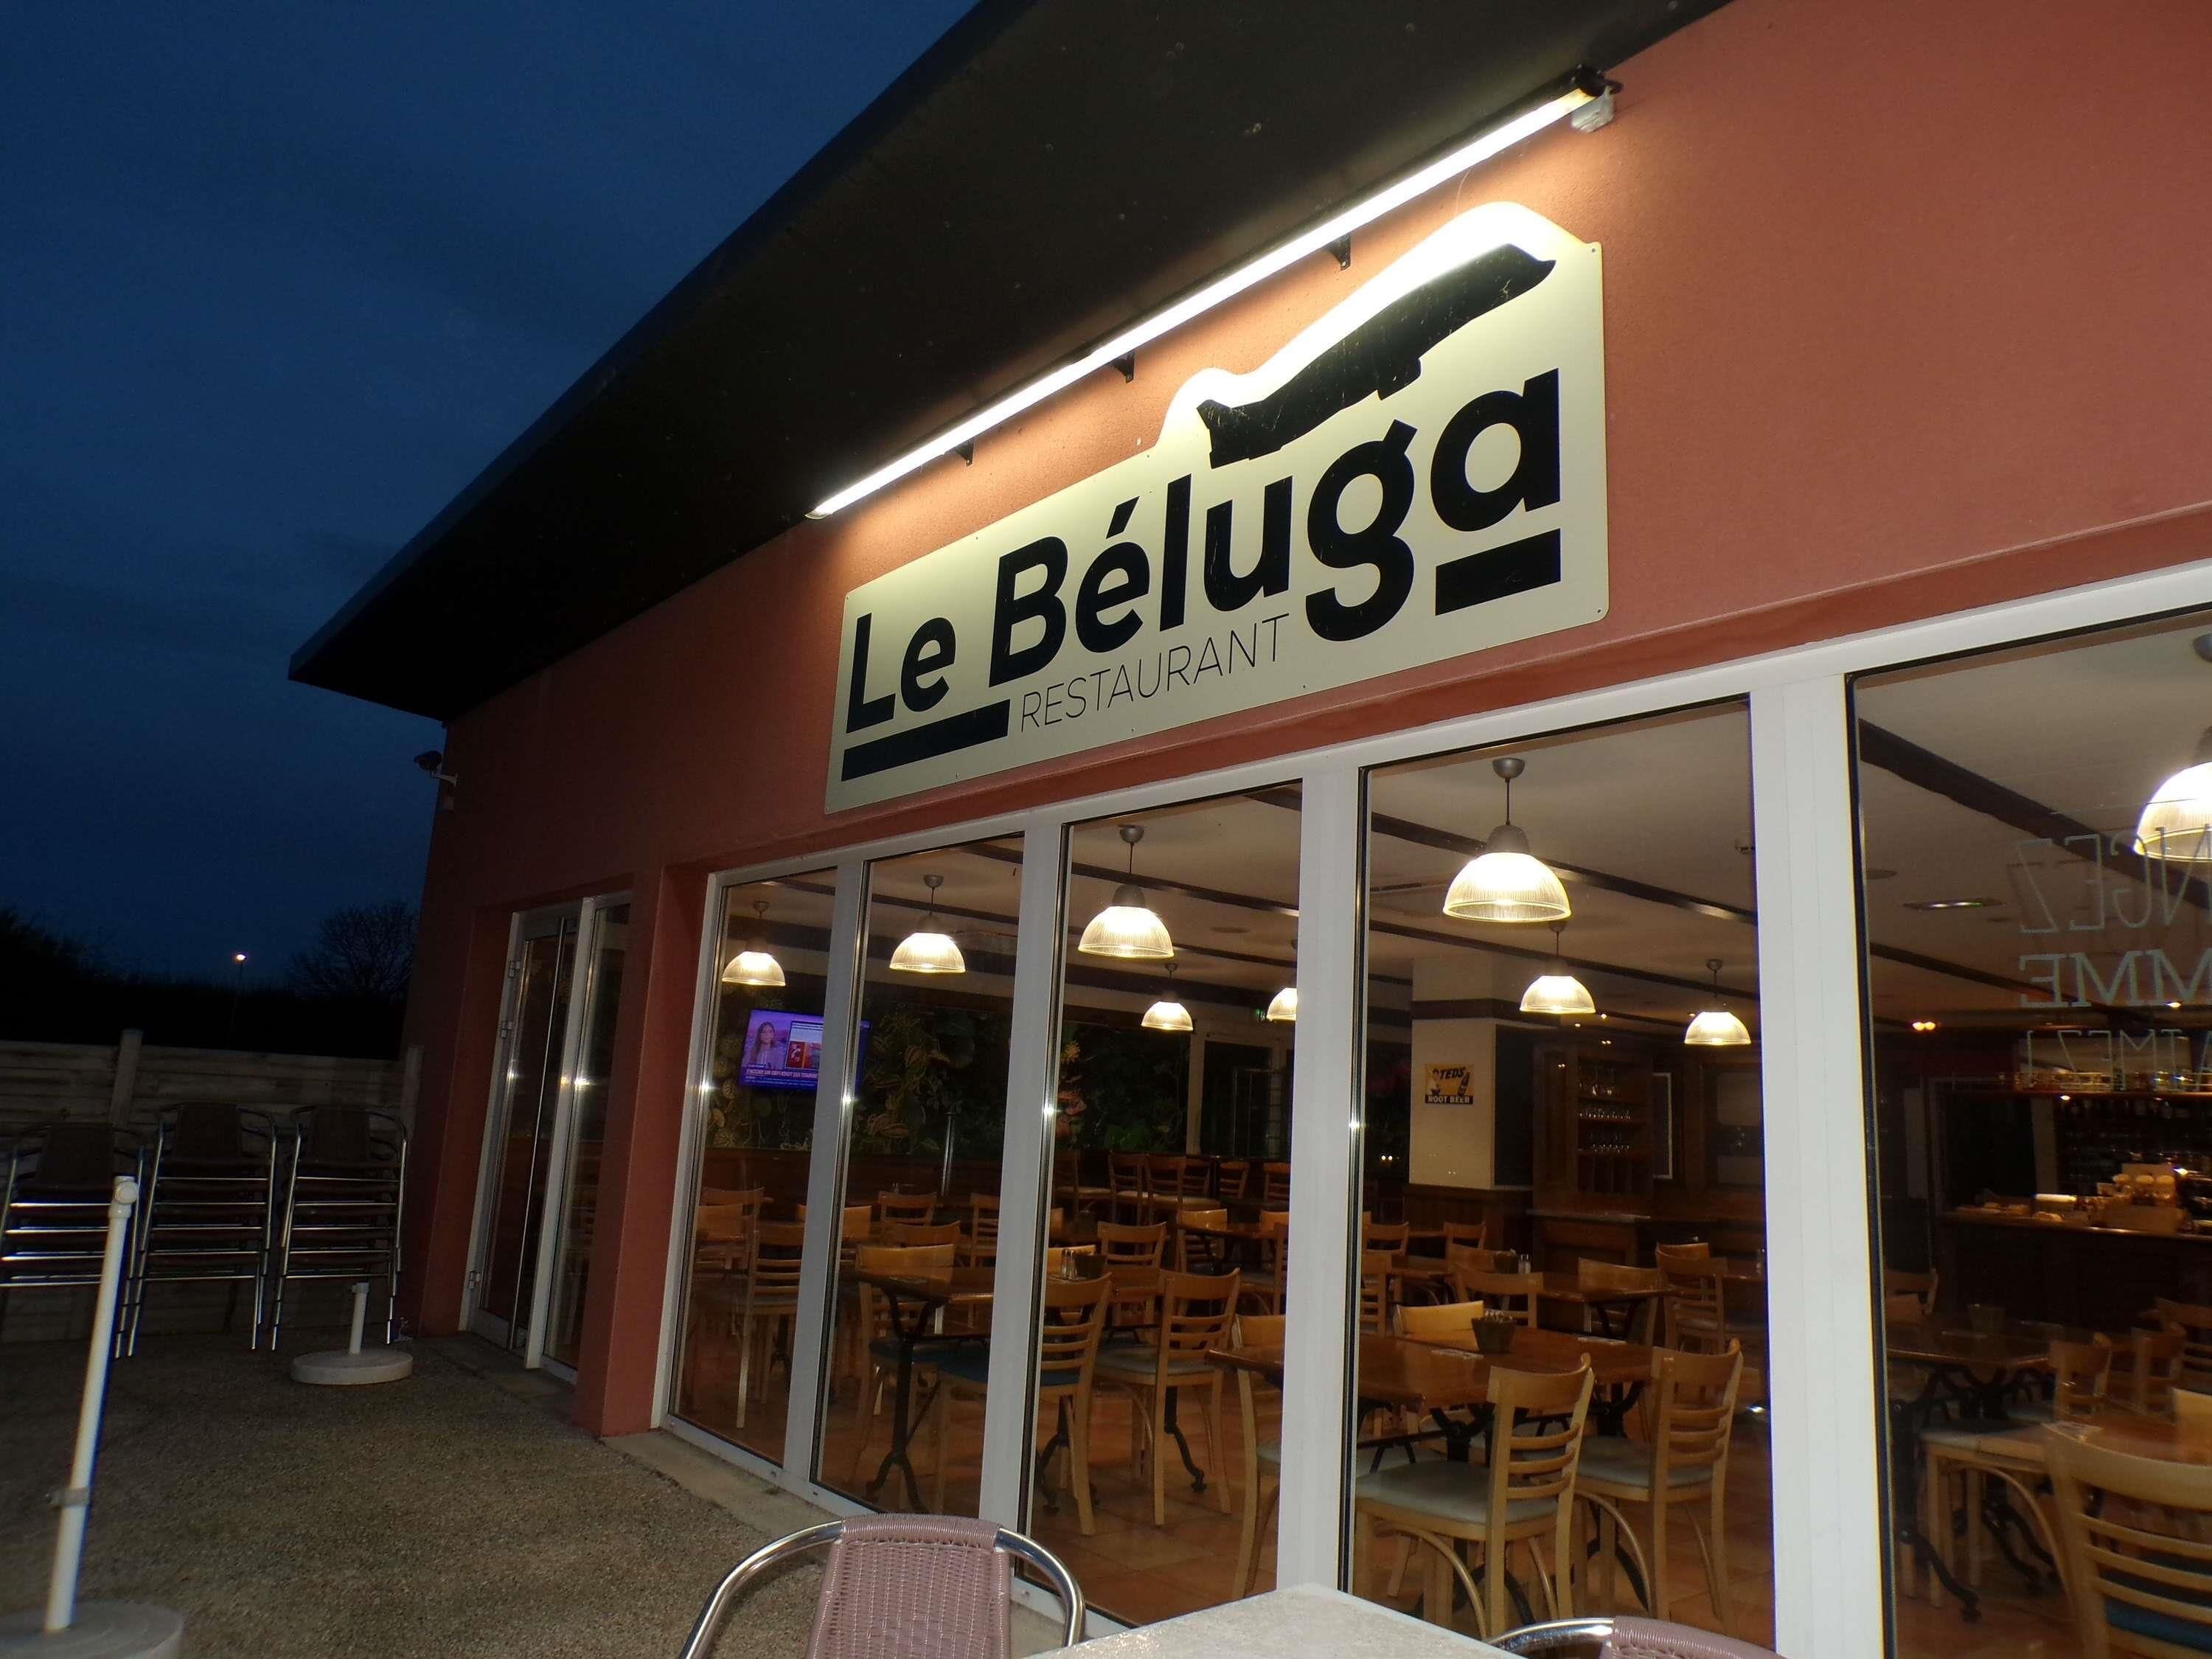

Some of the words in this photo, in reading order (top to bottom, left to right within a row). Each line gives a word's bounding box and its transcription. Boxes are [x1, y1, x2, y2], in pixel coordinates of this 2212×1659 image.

[845, 613, 956, 734] Le
[988, 368, 1561, 688] Béluga
[1020, 613, 1290, 733] RESTAURANT
